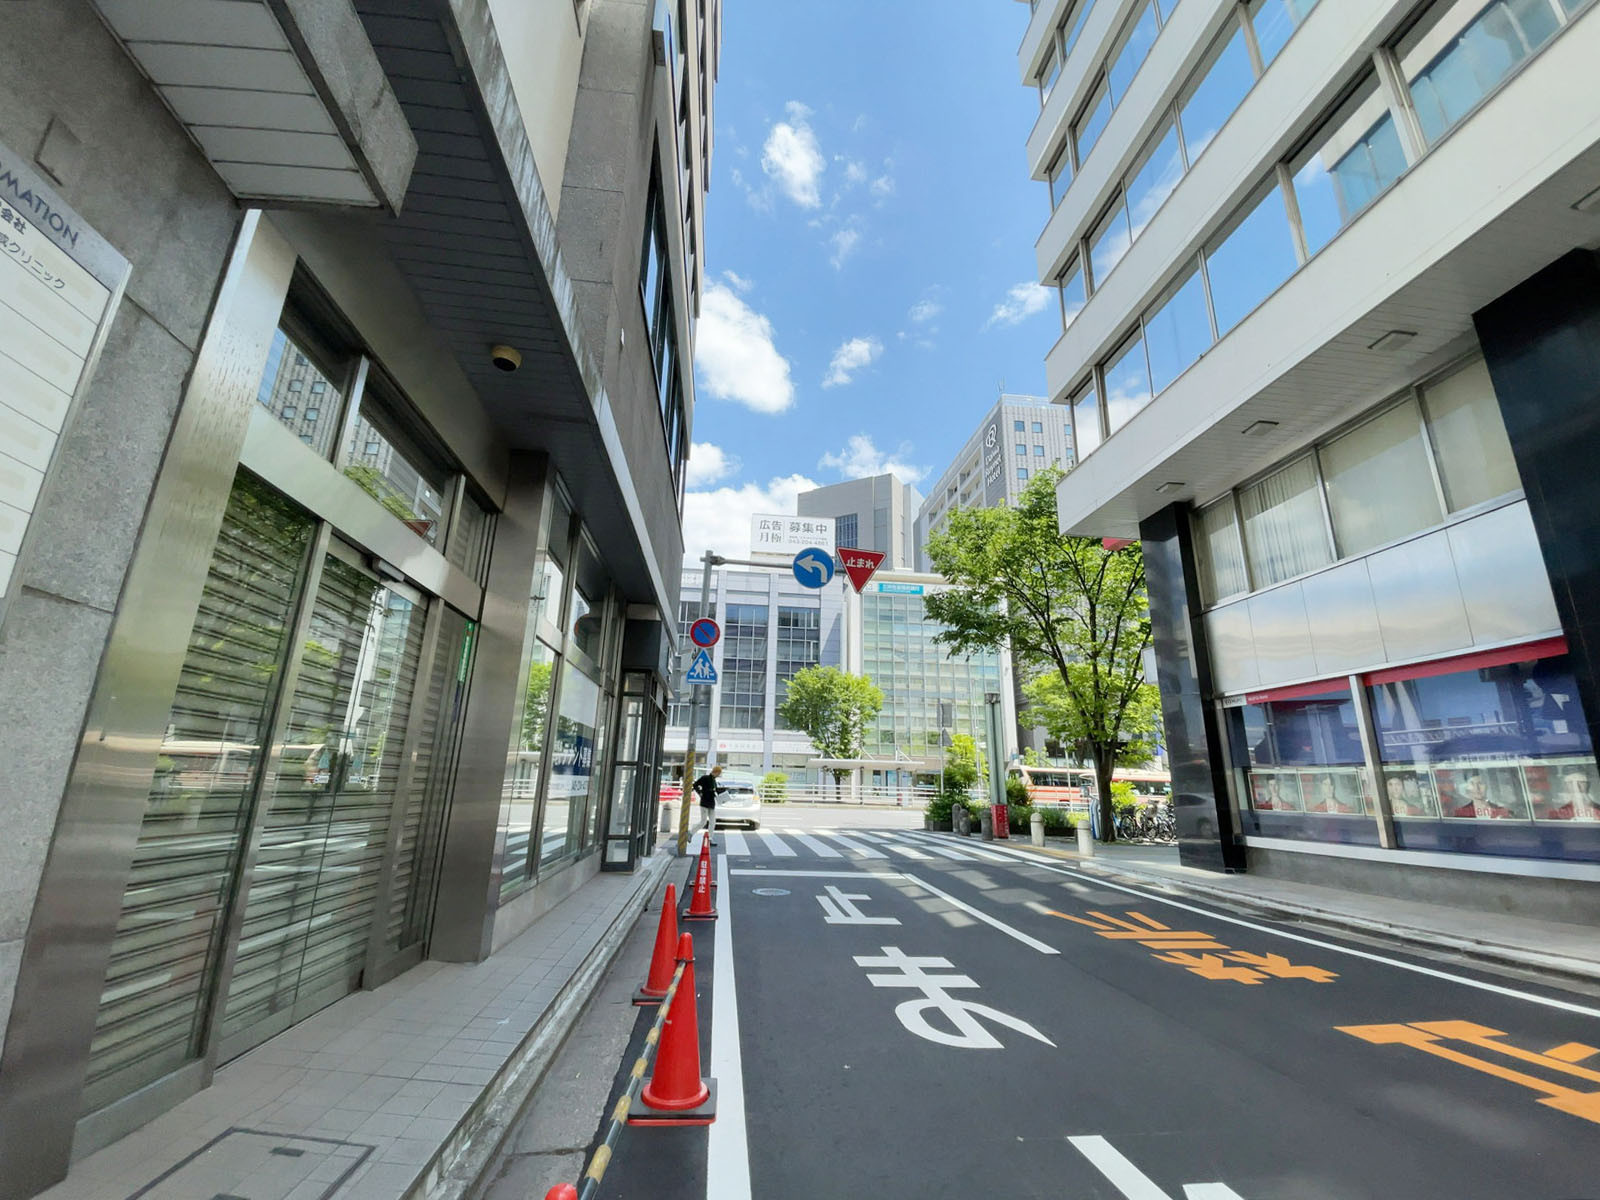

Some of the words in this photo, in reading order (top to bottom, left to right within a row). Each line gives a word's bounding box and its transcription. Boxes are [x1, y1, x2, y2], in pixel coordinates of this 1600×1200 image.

[0, 166, 78, 248] MATION
[0, 202, 26, 234] 会社
[987, 466, 1001, 486] Hotel
[759, 520, 782, 531] 広告
[789, 521, 827, 534] 募集中
[846, 557, 875, 569] 止まれ
